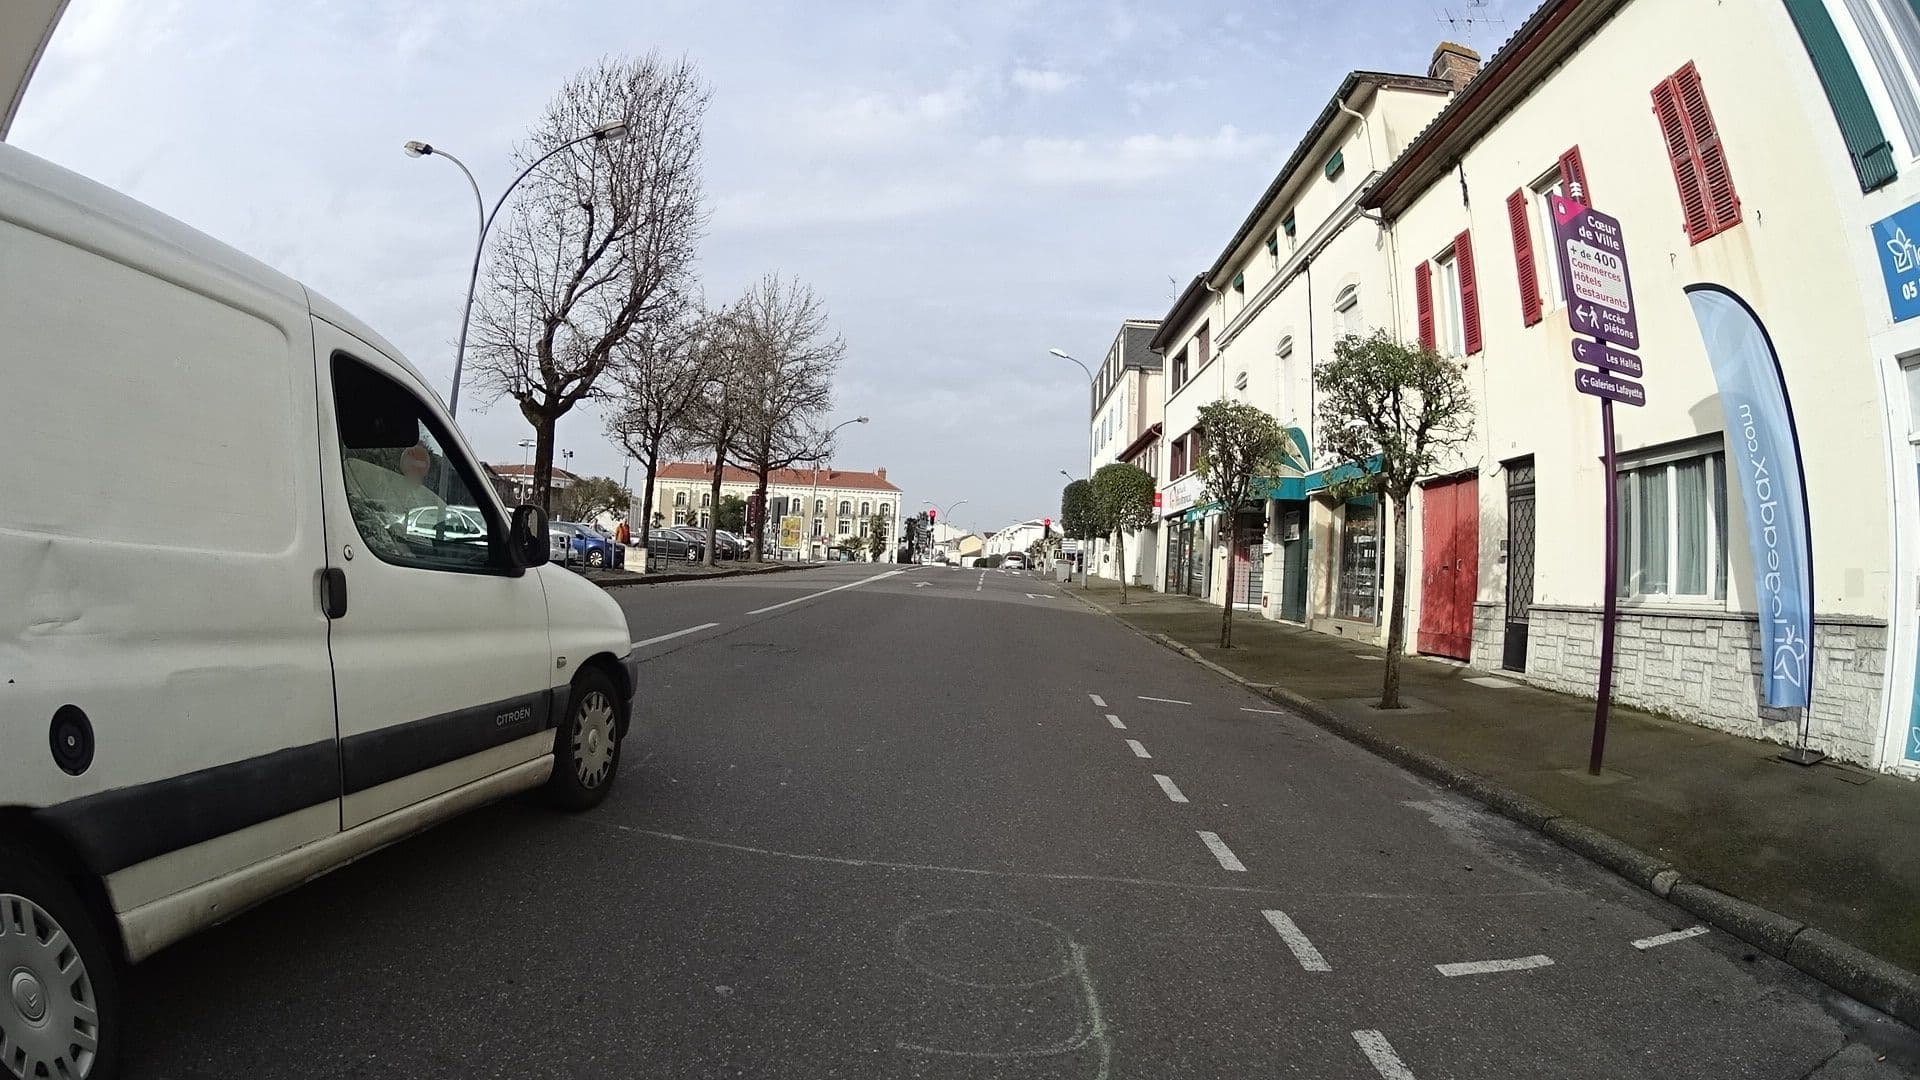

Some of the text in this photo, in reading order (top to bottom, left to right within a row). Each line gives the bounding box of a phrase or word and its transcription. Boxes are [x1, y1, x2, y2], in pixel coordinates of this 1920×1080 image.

[1587, 215, 1617, 236] Cœur
[1578, 225, 1620, 251] de Ville
[1571, 257, 1622, 282] Commerces
[1580, 250, 1592, 261] de
[1594, 251, 1617, 270] 400
[1573, 270, 1602, 288] Hôtels
[1575, 283, 1628, 309] Restaurants
[1902, 280, 1918, 300] 05
[1602, 310, 1626, 325] Accès
[1603, 322, 1634, 340] piétons
[1605, 352, 1641, 371] Les Halles
[1590, 377, 1643, 399] Galeries Lafayette
